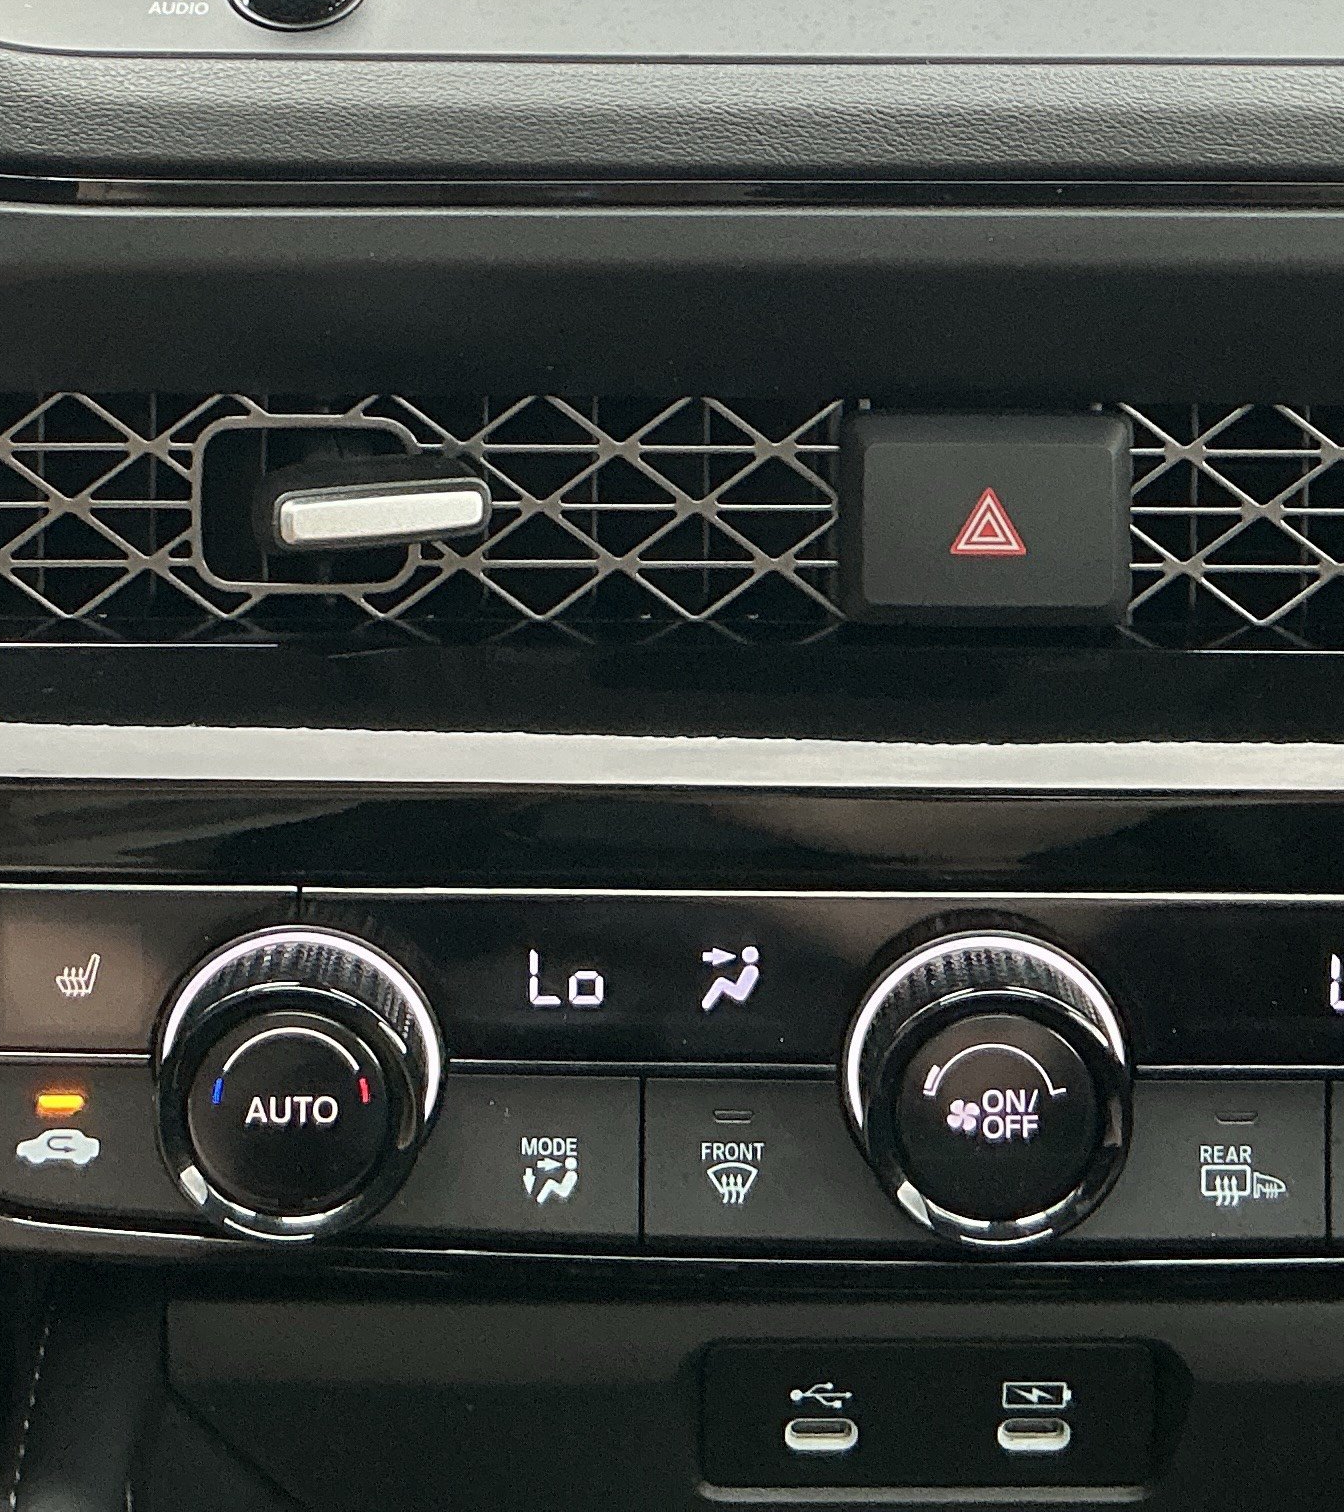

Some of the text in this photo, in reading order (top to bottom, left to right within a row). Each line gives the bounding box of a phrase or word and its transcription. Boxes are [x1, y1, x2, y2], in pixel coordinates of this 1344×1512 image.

[148, 1, 210, 16] AUDIO
[528, 948, 604, 1007] Lo
[244, 1095, 339, 1126] AUTO
[981, 1088, 1039, 1115] ON/
[982, 1115, 1040, 1141] OFF
[520, 1136, 579, 1157] MODE
[700, 1142, 765, 1162] FRONT
[1199, 1145, 1253, 1164] REAR
